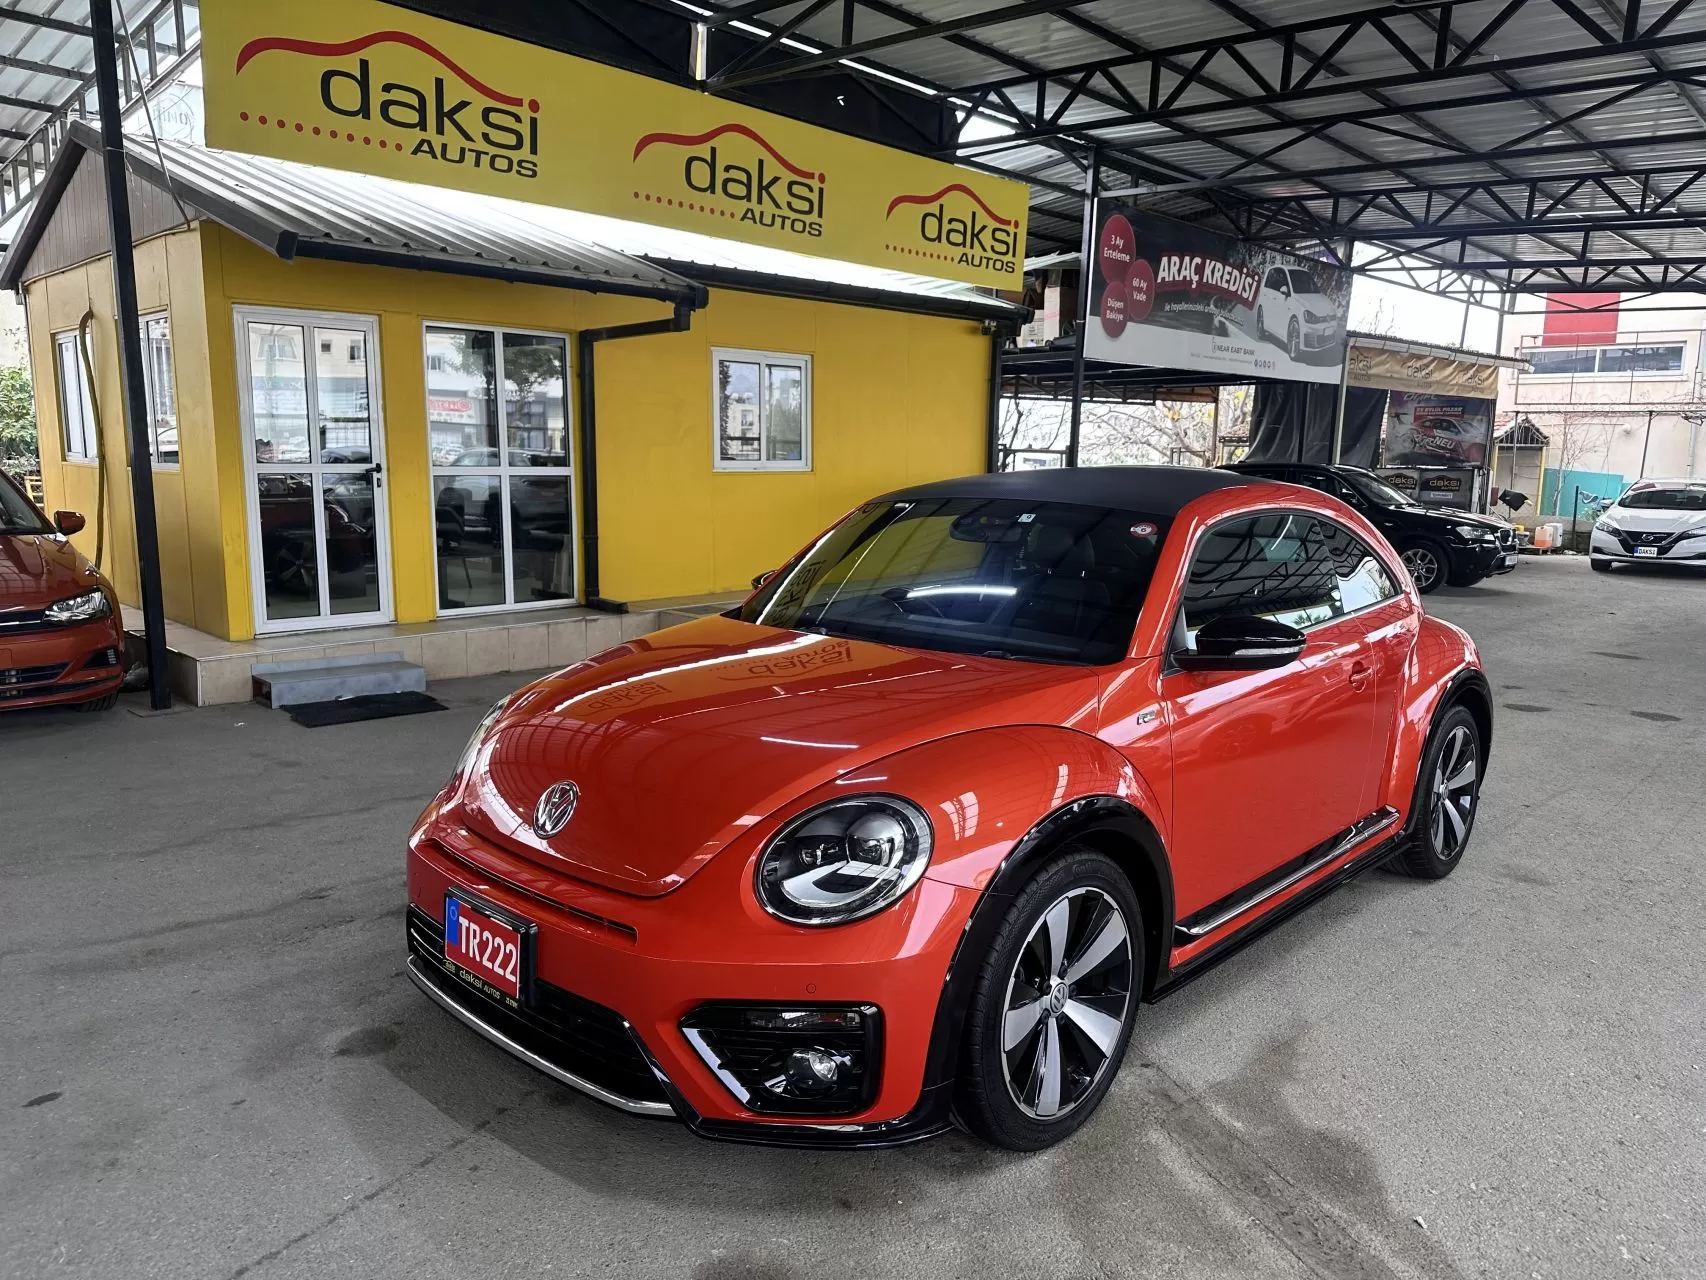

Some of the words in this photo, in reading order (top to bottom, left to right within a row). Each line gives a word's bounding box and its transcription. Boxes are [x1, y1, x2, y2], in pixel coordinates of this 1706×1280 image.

[319, 58, 540, 156] daksi
[410, 138, 539, 179] AUTOS
[684, 146, 826, 219] daksi
[739, 207, 823, 238] AUTOS
[920, 204, 1020, 259] daksi
[1110, 234, 1115, 245] 3
[1115, 236, 1124, 249] Ay
[957, 252, 1016, 274] AUTOS
[1103, 247, 1130, 262] Erteleme
[1132, 277, 1140, 287] 60
[1140, 279, 1148, 291] Ay
[1157, 255, 1202, 289] ARAÇ
[1202, 259, 1259, 302] KREDİSİ
[1132, 291, 1147, 302] Vade
[1105, 310, 1124, 322] Bakiye
[1217, 344, 1230, 353] NEAR
[1230, 345, 1243, 354] EAST
[1243, 347, 1255, 356] BANK
[1349, 354, 1372, 372] aksi
[1388, 475, 1416, 485] daksi
[1429, 479, 1460, 487] daksi
[458, 916, 517, 983] TR222
[459, 969, 483, 990] daksi
[483, 984, 501, 1000] AUTOS
